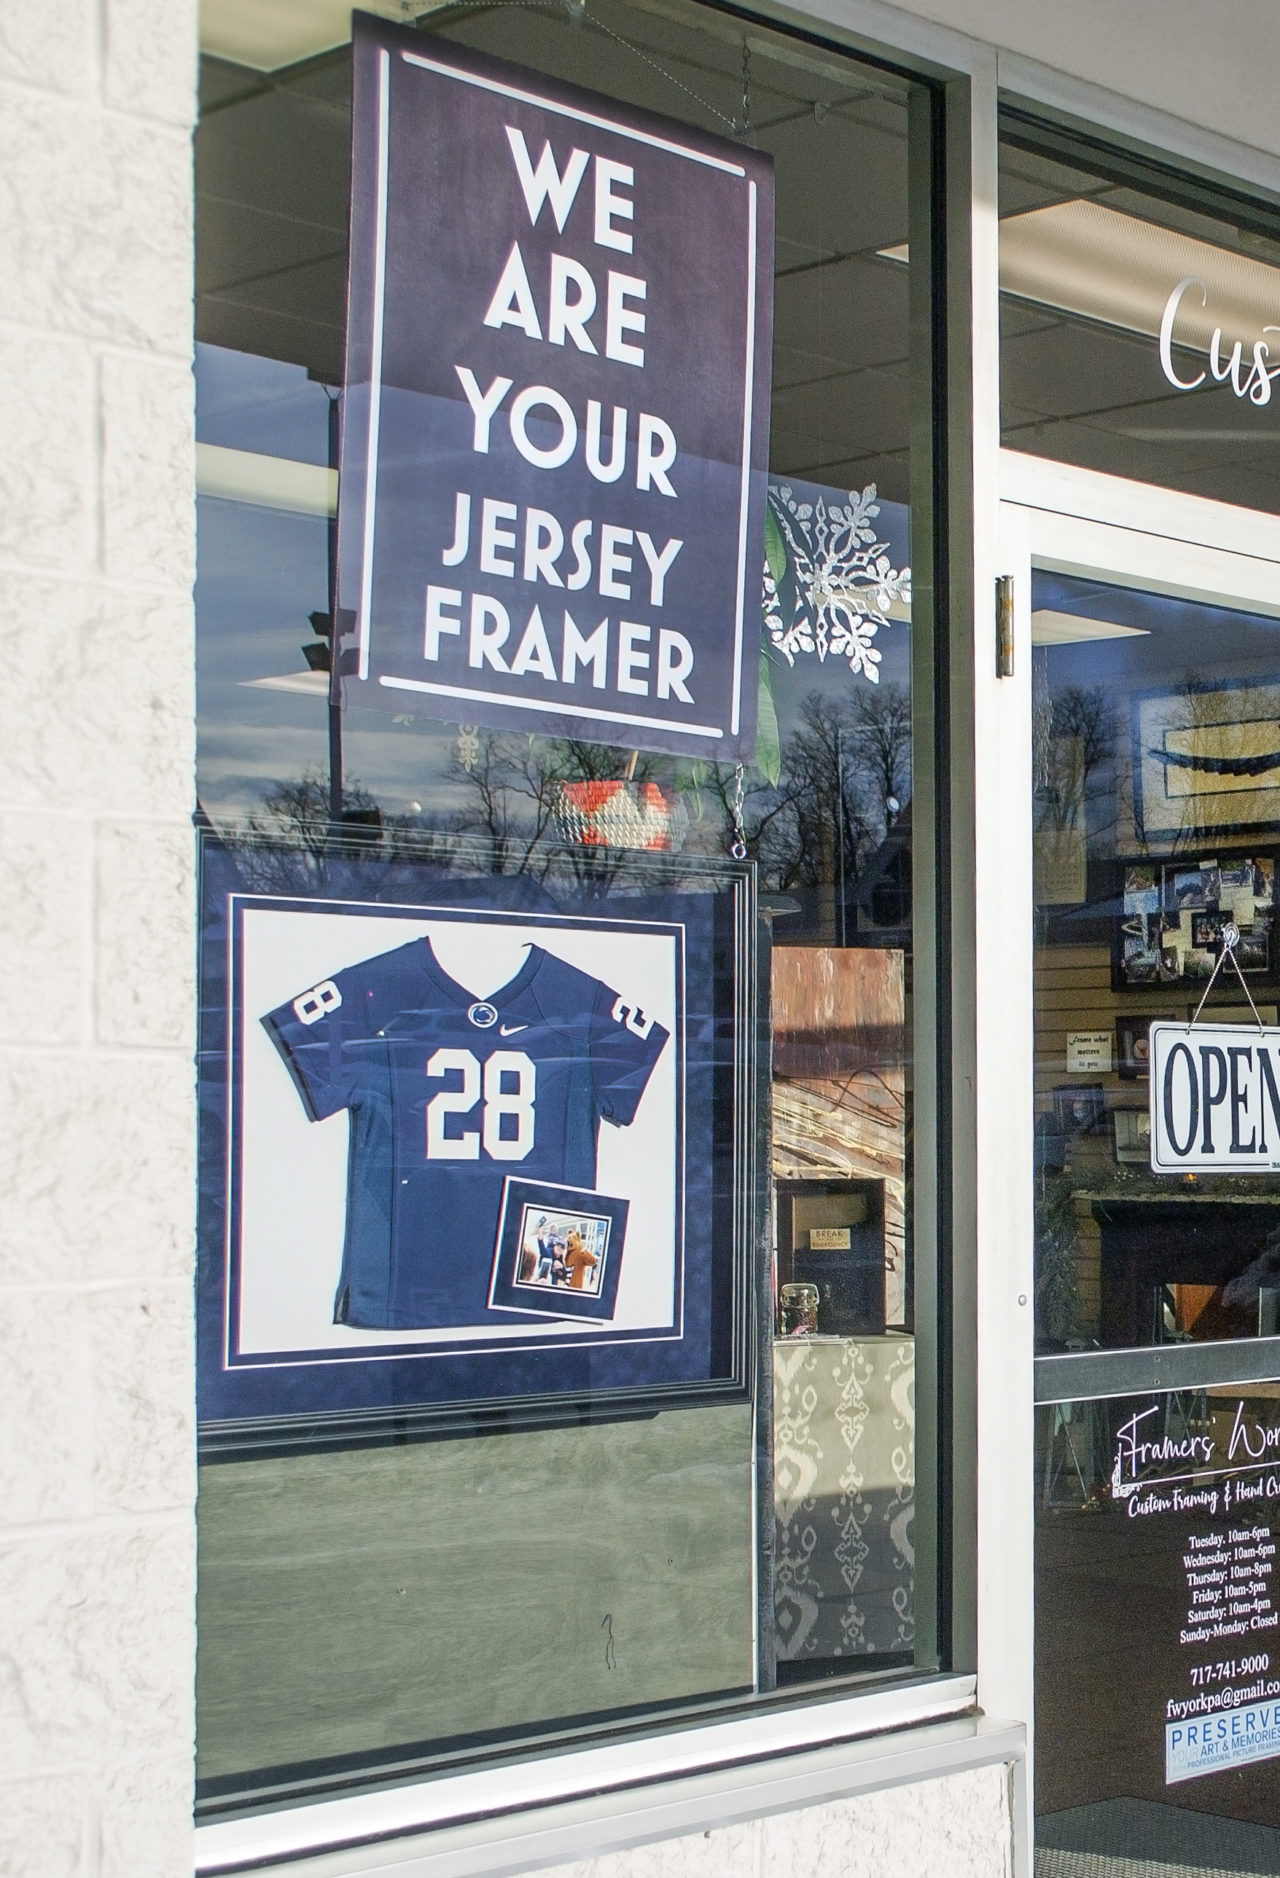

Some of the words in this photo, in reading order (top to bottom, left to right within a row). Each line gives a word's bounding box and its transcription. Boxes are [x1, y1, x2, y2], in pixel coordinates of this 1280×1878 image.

[505, 125, 634, 254] WE
[483, 241, 647, 367] ARE
[454, 365, 678, 498] YOUR
[442, 492, 683, 607] JERSEY
[423, 585, 695, 704] FRAMER
[294, 980, 343, 1025] 8
[612, 996, 655, 1040] 2
[427, 1049, 536, 1160] 28
[816, 1230, 844, 1238] BREAK
[1128, 1493, 1171, 1518] Custom
[1172, 1489, 1219, 1514] Framing
[1224, 1481, 1232, 1511] &
[1236, 1478, 1263, 1500] Hand
[1228, 1526, 1270, 1543] 10am-6pm
[1183, 1550, 1232, 1568] Wednesday:
[1234, 1543, 1276, 1560] 10am-6pm
[1187, 1569, 1228, 1586] Thursday:
[1230, 1562, 1272, 1579] 10am-8pm
[1192, 1588, 1222, 1604] Friday:
[1224, 1581, 1266, 1598] 10am-5pm
[1188, 1606, 1227, 1623] Saturday:
[1228, 1598, 1271, 1616] 10am-4pm
[1180, 1620, 1249, 1643] Sunday-Monday:
[1250, 1612, 1279, 1629] Closed
[1190, 1653, 1269, 1686] 717-741-9000
[1187, 1752, 1231, 1769] PROFESSIONAL
[1232, 1745, 1257, 1757] PICTURE
[1200, 1742, 1220, 1757] ART
[1222, 1740, 1229, 1752] &
